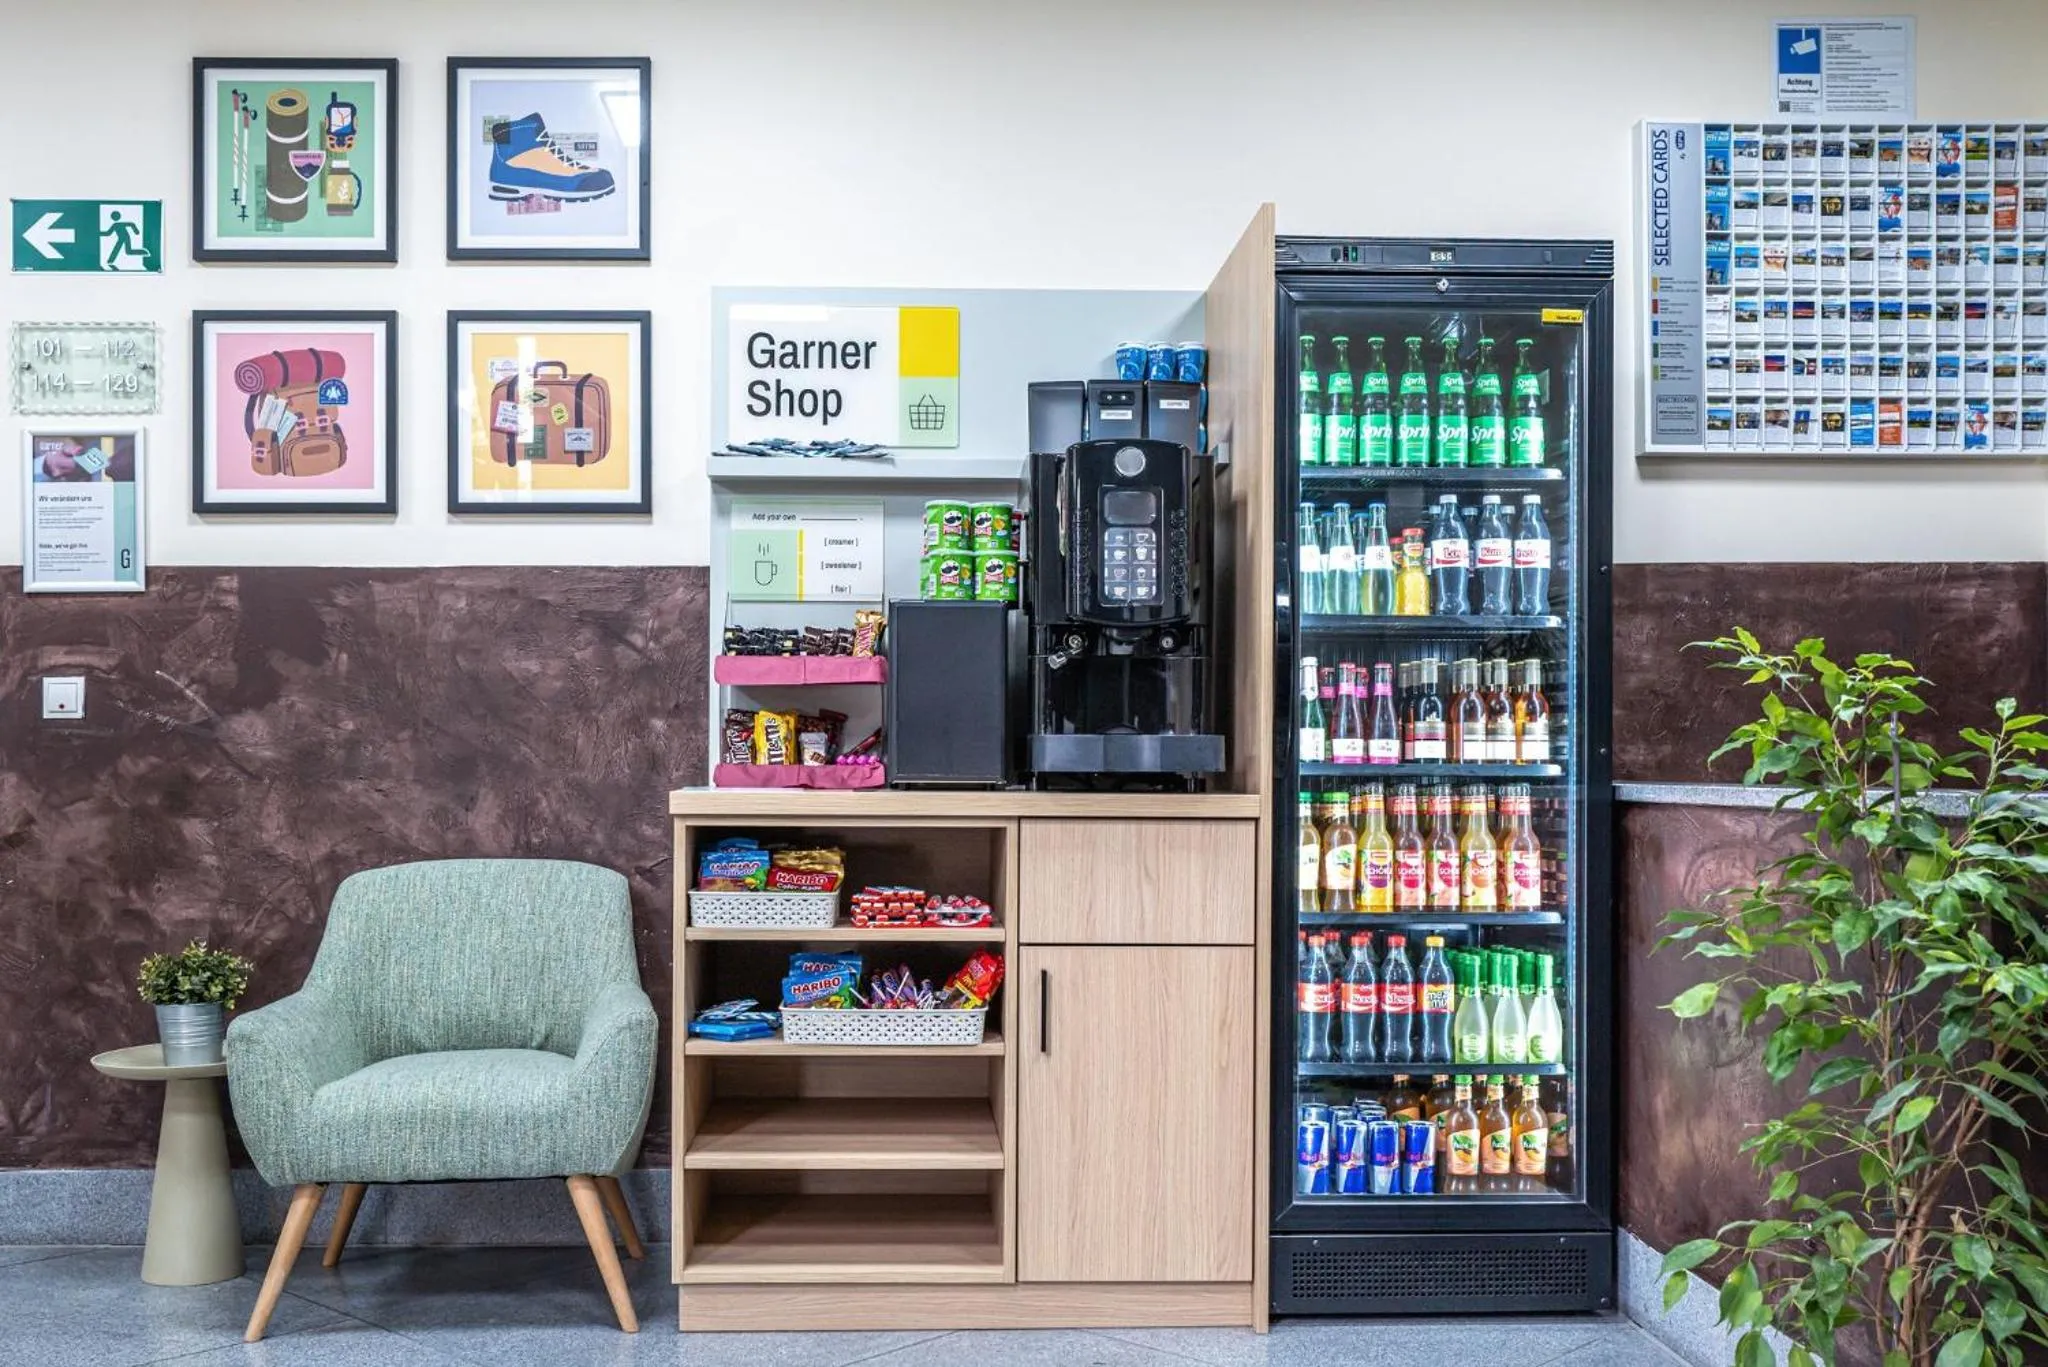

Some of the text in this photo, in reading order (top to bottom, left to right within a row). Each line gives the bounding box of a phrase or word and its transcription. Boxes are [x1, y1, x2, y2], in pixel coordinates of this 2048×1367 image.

[1654, 129, 1669, 266] SELECTED CARDS
[33, 336, 63, 357] 101
[103, 337, 136, 357] 112
[746, 331, 878, 370] Garner
[33, 371, 66, 393] 114
[103, 372, 140, 393] 129
[746, 378, 843, 426] Shop
[752, 512, 797, 522] Add your own
[120, 548, 131, 569] G
[776, 871, 829, 886] HARIBO
[791, 976, 842, 995] HARIBO
